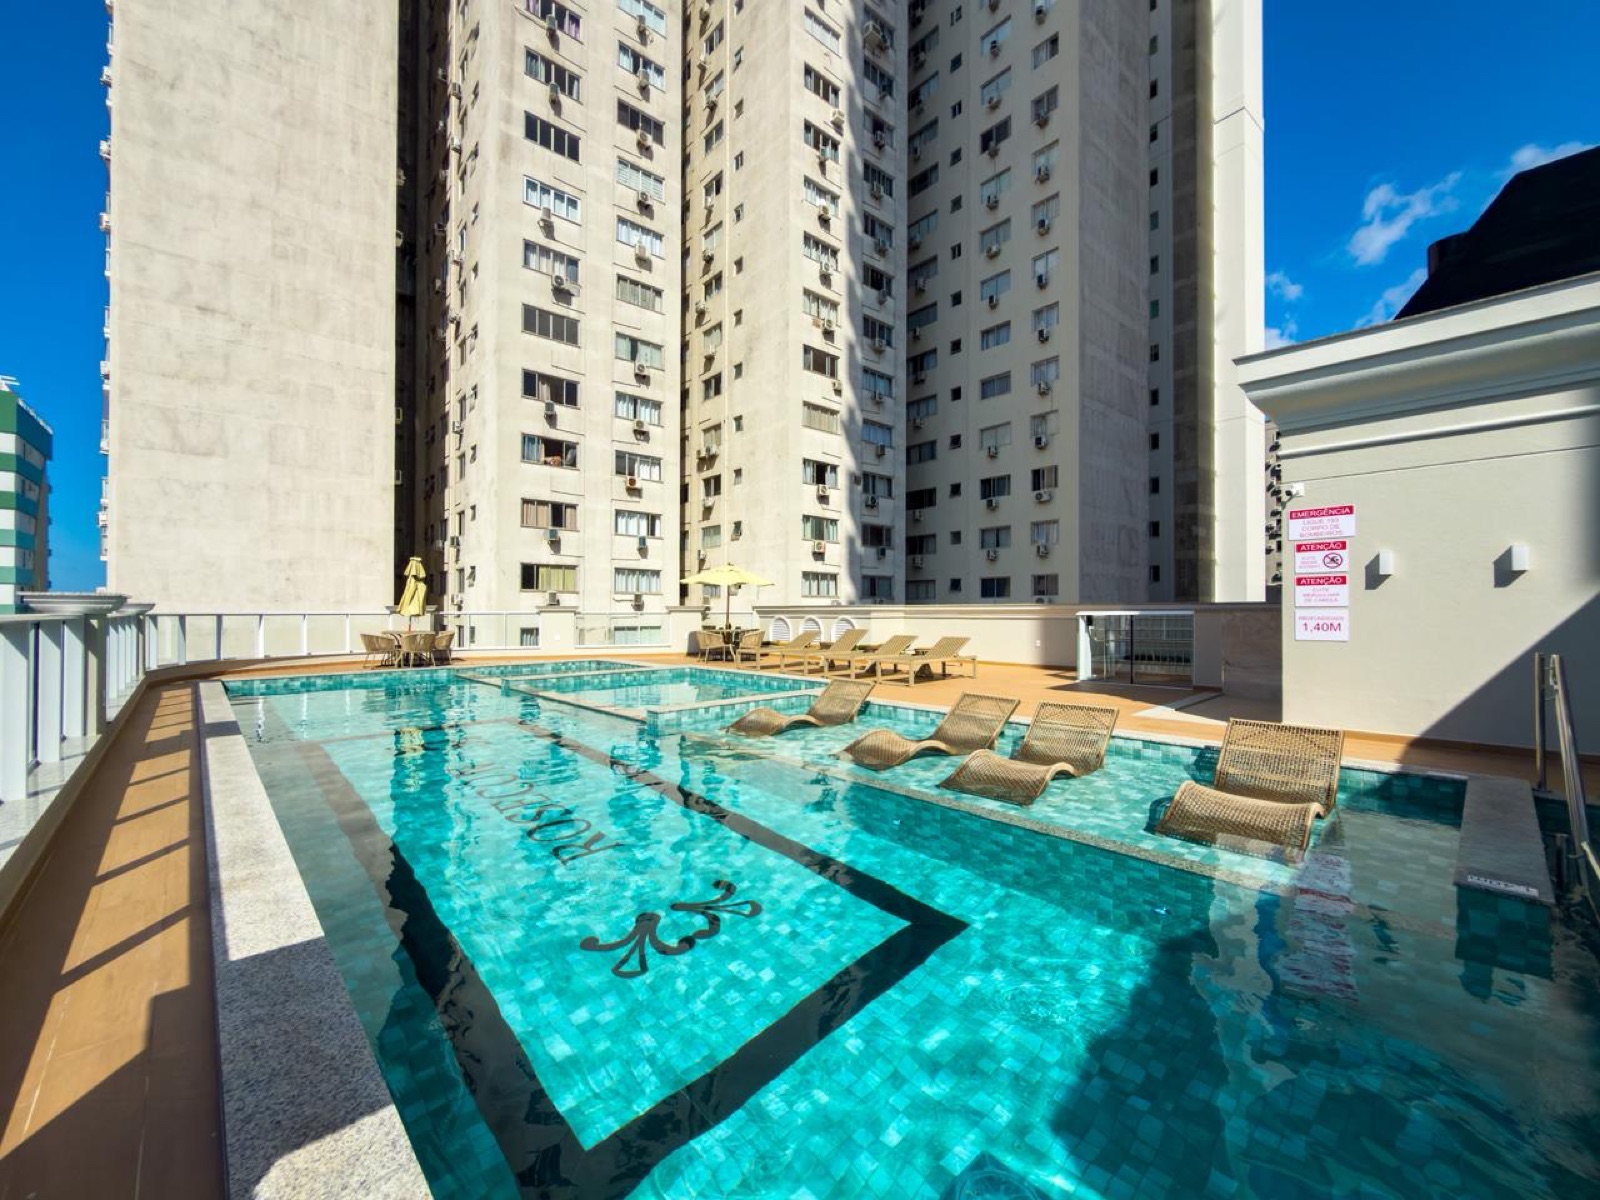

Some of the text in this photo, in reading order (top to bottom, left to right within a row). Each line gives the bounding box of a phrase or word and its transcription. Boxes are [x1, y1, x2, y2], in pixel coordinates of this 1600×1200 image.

[1291, 507, 1350, 519] EMERGÊNCIA
[1300, 542, 1342, 552] ATENÇÃO
[1300, 576, 1342, 586] ATENÇÃO
